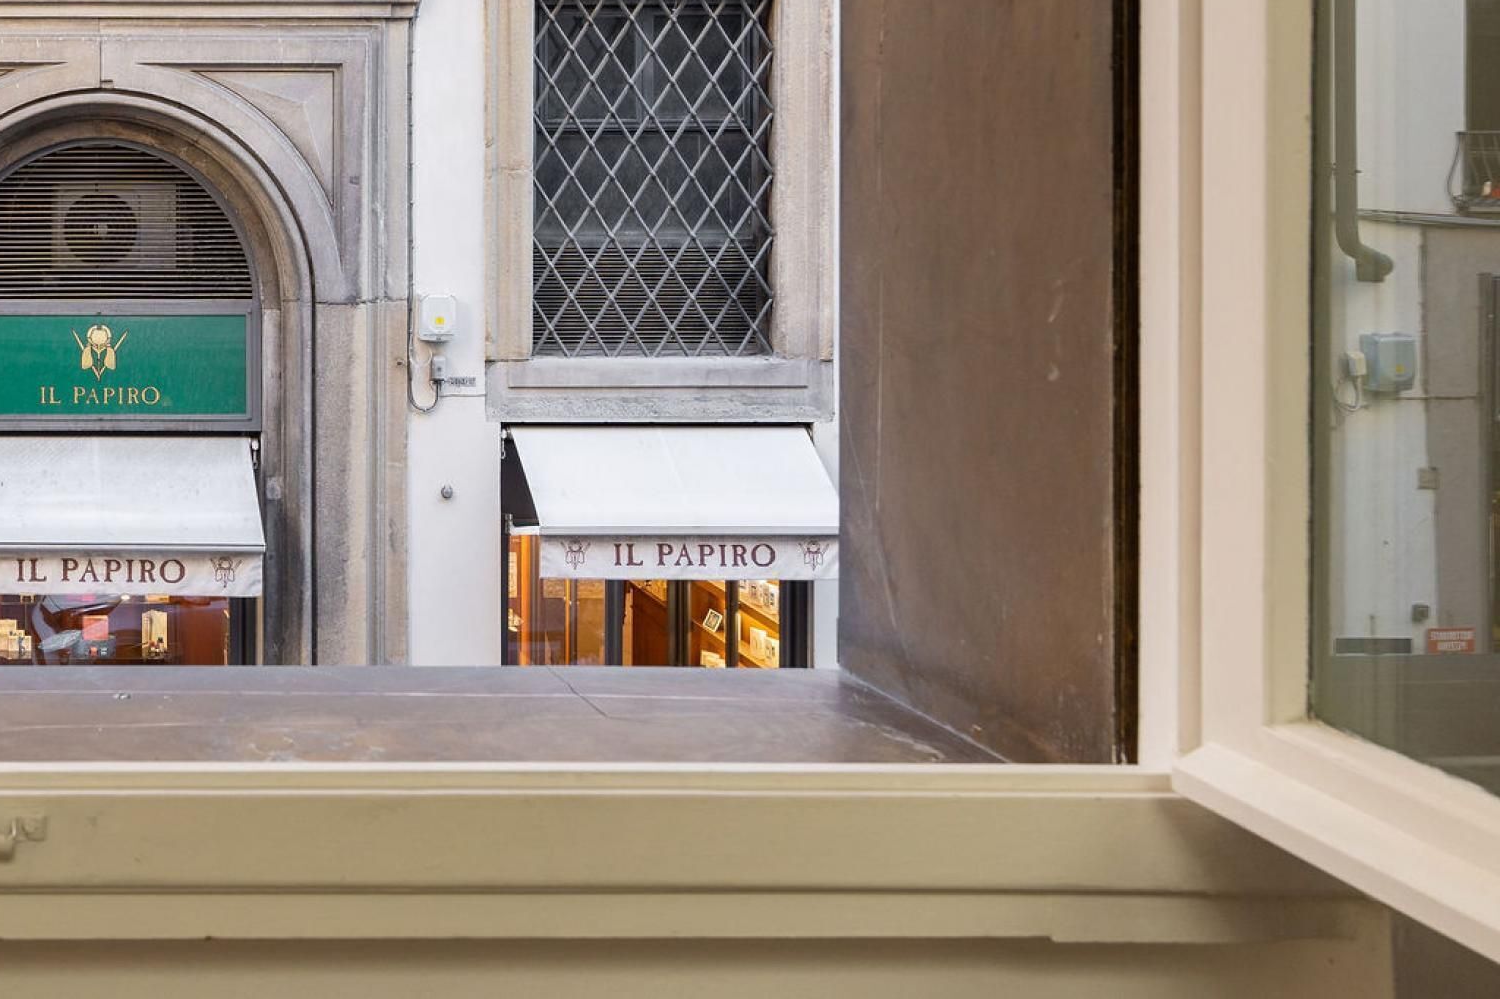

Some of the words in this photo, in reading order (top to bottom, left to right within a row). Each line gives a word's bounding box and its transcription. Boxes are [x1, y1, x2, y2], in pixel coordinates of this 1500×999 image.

[40, 386, 61, 404] IL
[73, 386, 161, 405] PAPIRO
[614, 543, 644, 566] IL
[656, 543, 776, 567] PAPIRO
[16, 558, 47, 582] IL
[61, 558, 186, 584] PAPIRO
